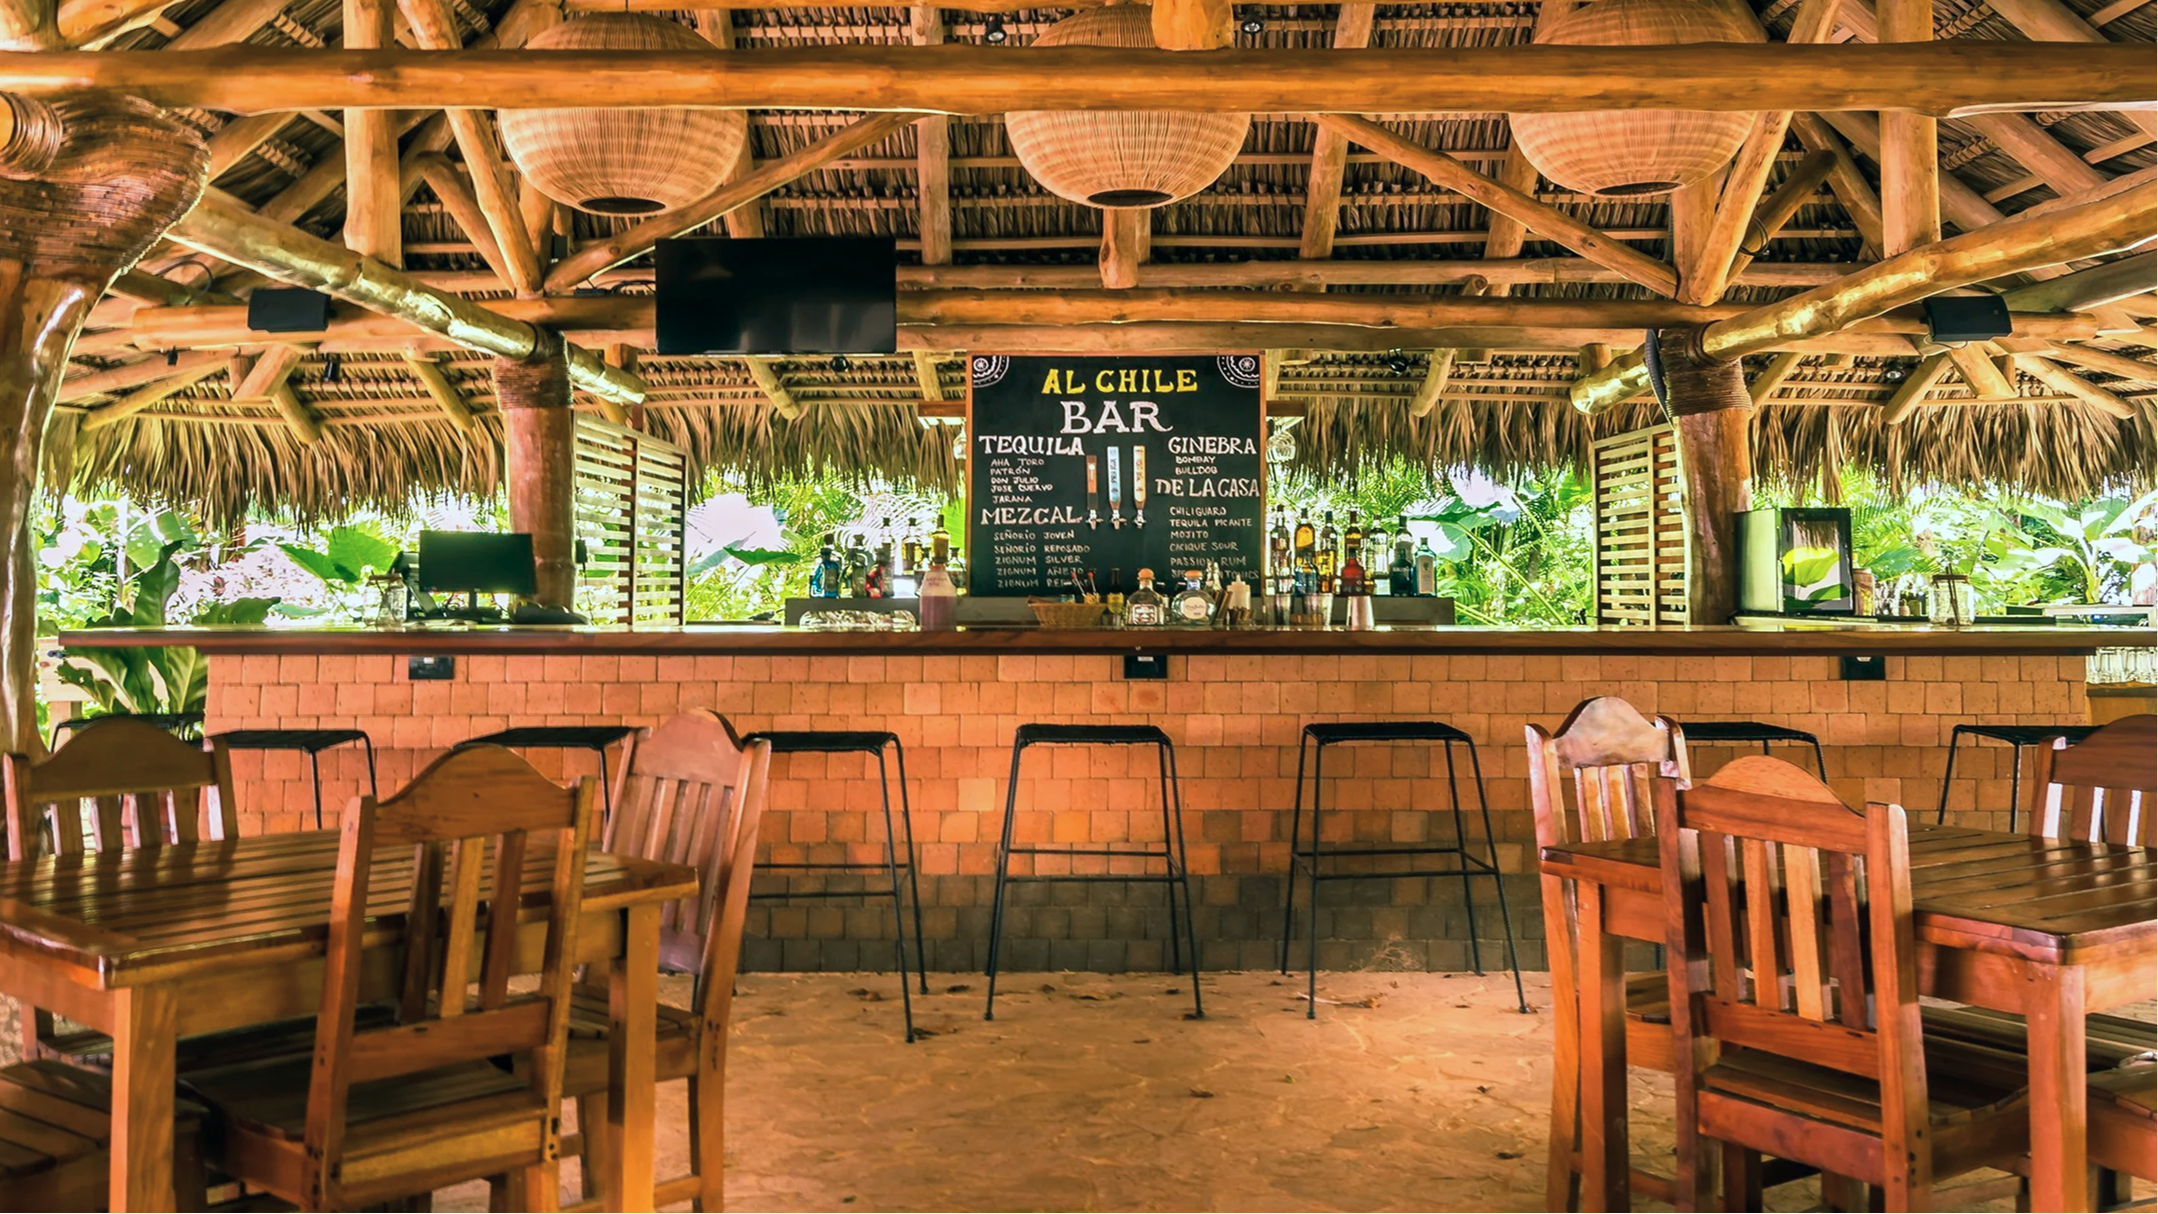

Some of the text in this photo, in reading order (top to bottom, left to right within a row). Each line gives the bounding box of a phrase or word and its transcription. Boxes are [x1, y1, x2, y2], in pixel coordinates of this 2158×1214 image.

[1041, 368, 1198, 395] AL CHILE
[1060, 400, 1174, 434] BAR
[978, 435, 1085, 456] TEQUILA
[1168, 436, 1257, 455] GINEBRA
[1017, 458, 1045, 467] TORO
[1175, 456, 1216, 465] BOMBAY
[990, 465, 1031, 476] PATRÓN
[1175, 466, 1218, 475] BULLDOG
[1012, 476, 1039, 484] JULIO
[990, 483, 1053, 494] JOSE CUERVO
[1155, 478, 1260, 498] DE LA CASA
[992, 495, 1033, 504] JARANA
[980, 506, 1083, 525] MEZCAL
[1169, 518, 1253, 527] TEQUILA PICANTE
[1043, 529, 1075, 540] JOVEN
[1170, 530, 1209, 539] MOJITO
[1043, 544, 1091, 554] REPOSADO
[1211, 541, 1239, 551] SOUR
[1045, 555, 1082, 564] SILVER
[1220, 556, 1247, 566] RUM
